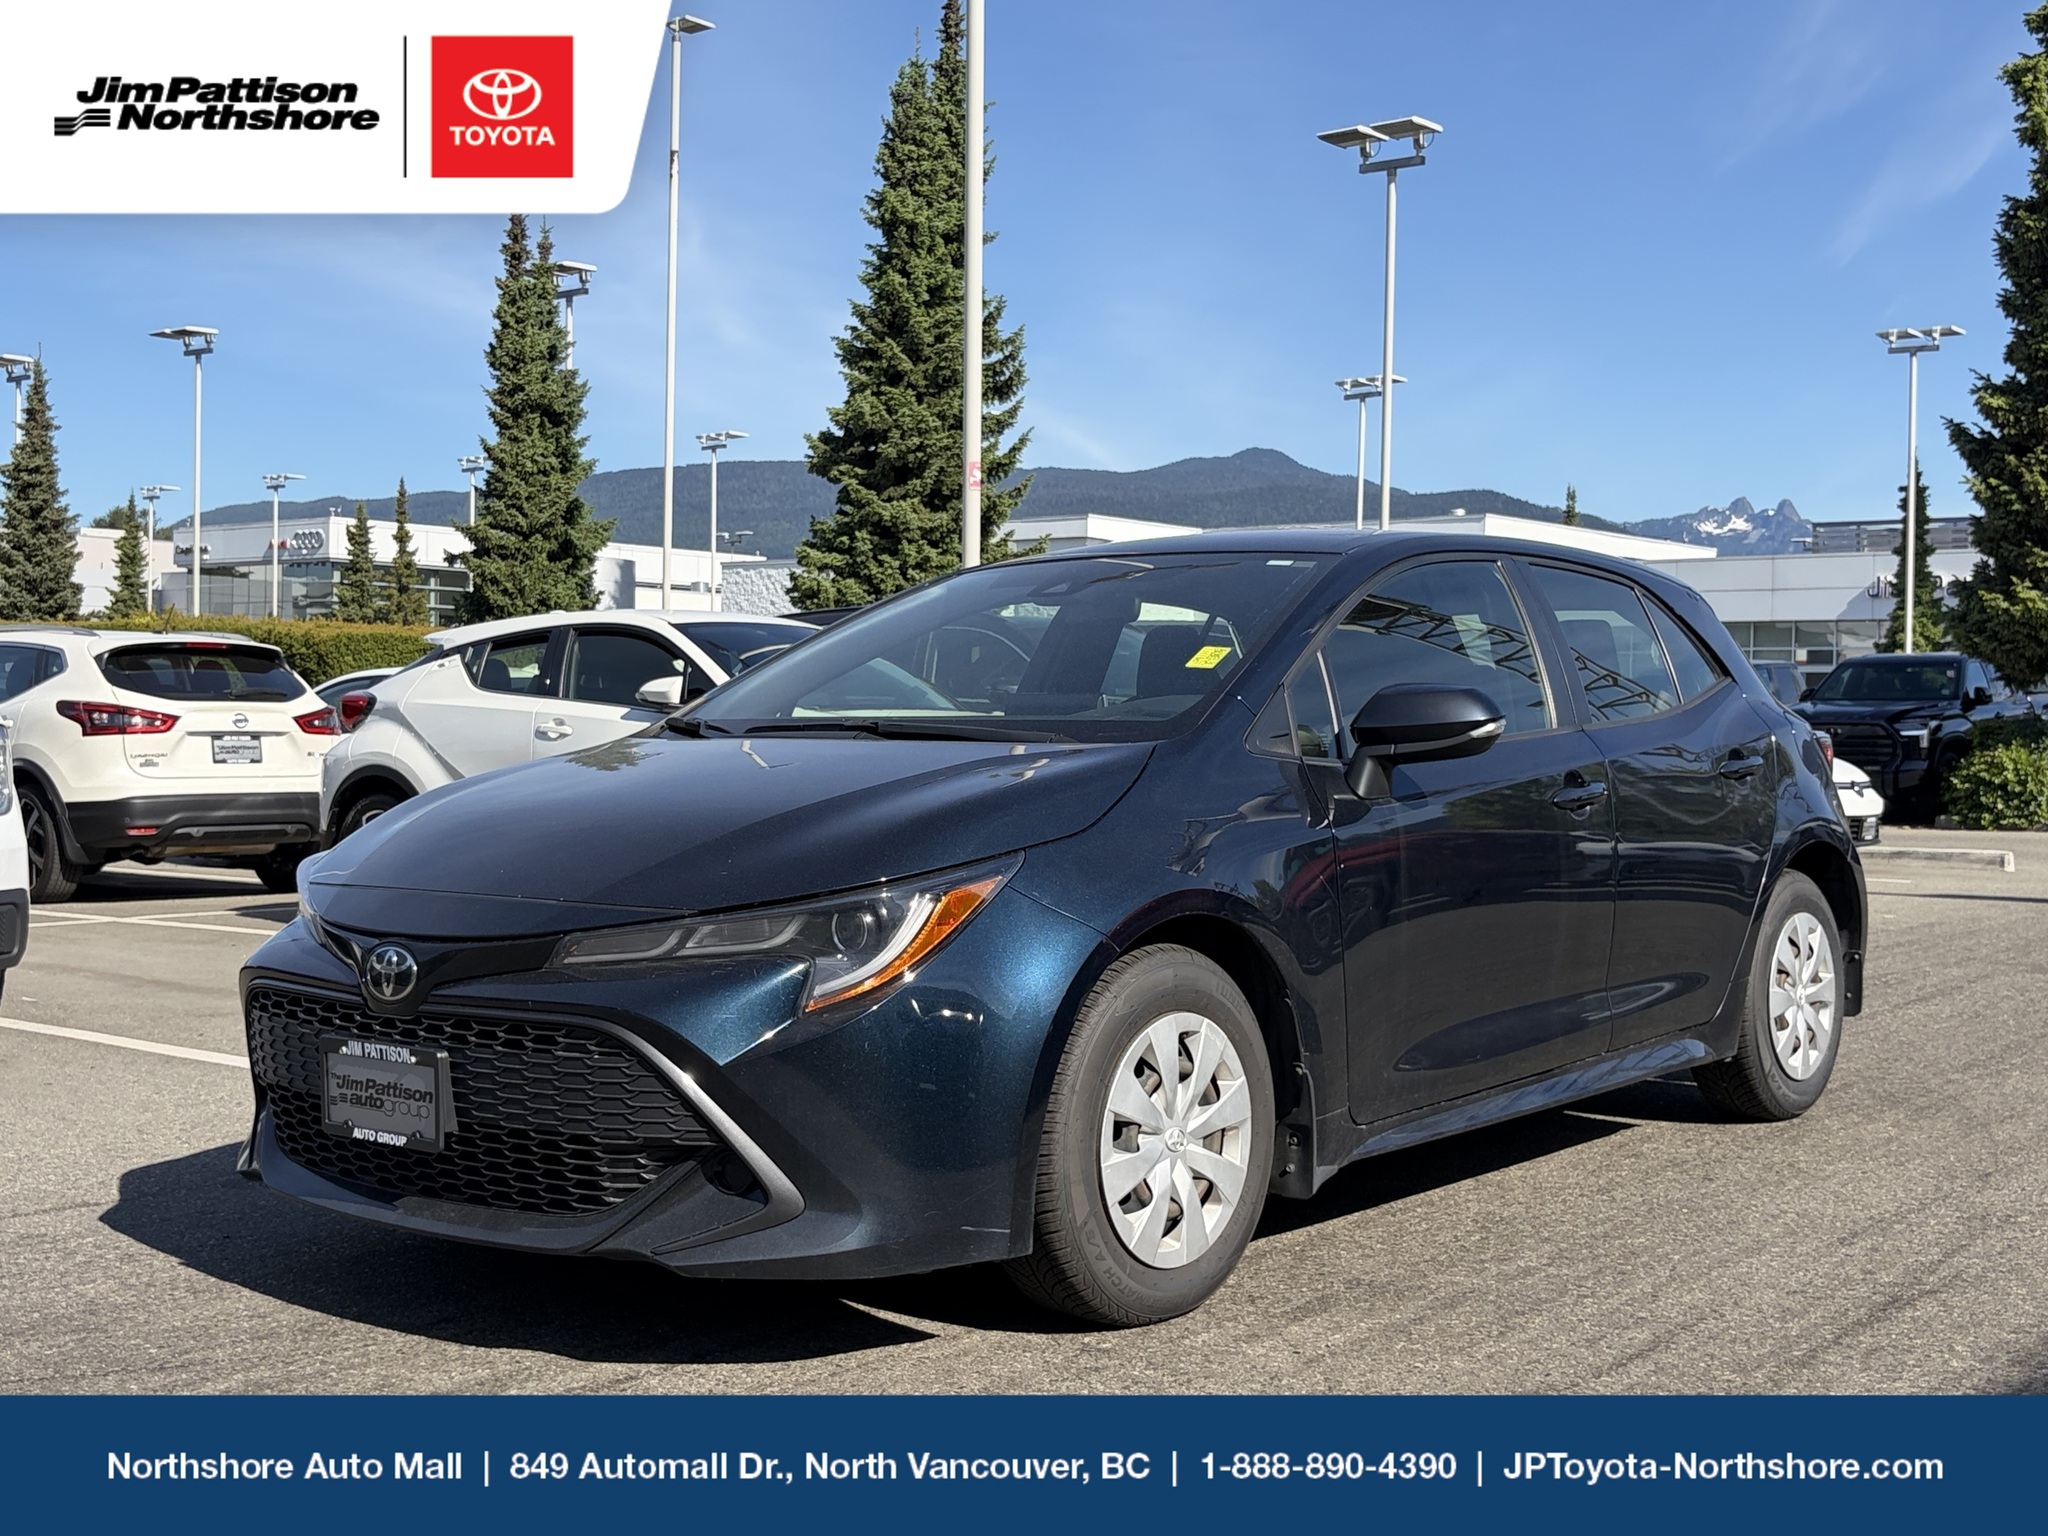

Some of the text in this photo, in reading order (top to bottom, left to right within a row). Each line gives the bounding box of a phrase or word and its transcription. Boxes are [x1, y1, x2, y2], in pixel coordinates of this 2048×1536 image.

[347, 1040, 411, 1064] JIM PATTISON
[353, 1127, 408, 1147] AUTO GROUP
